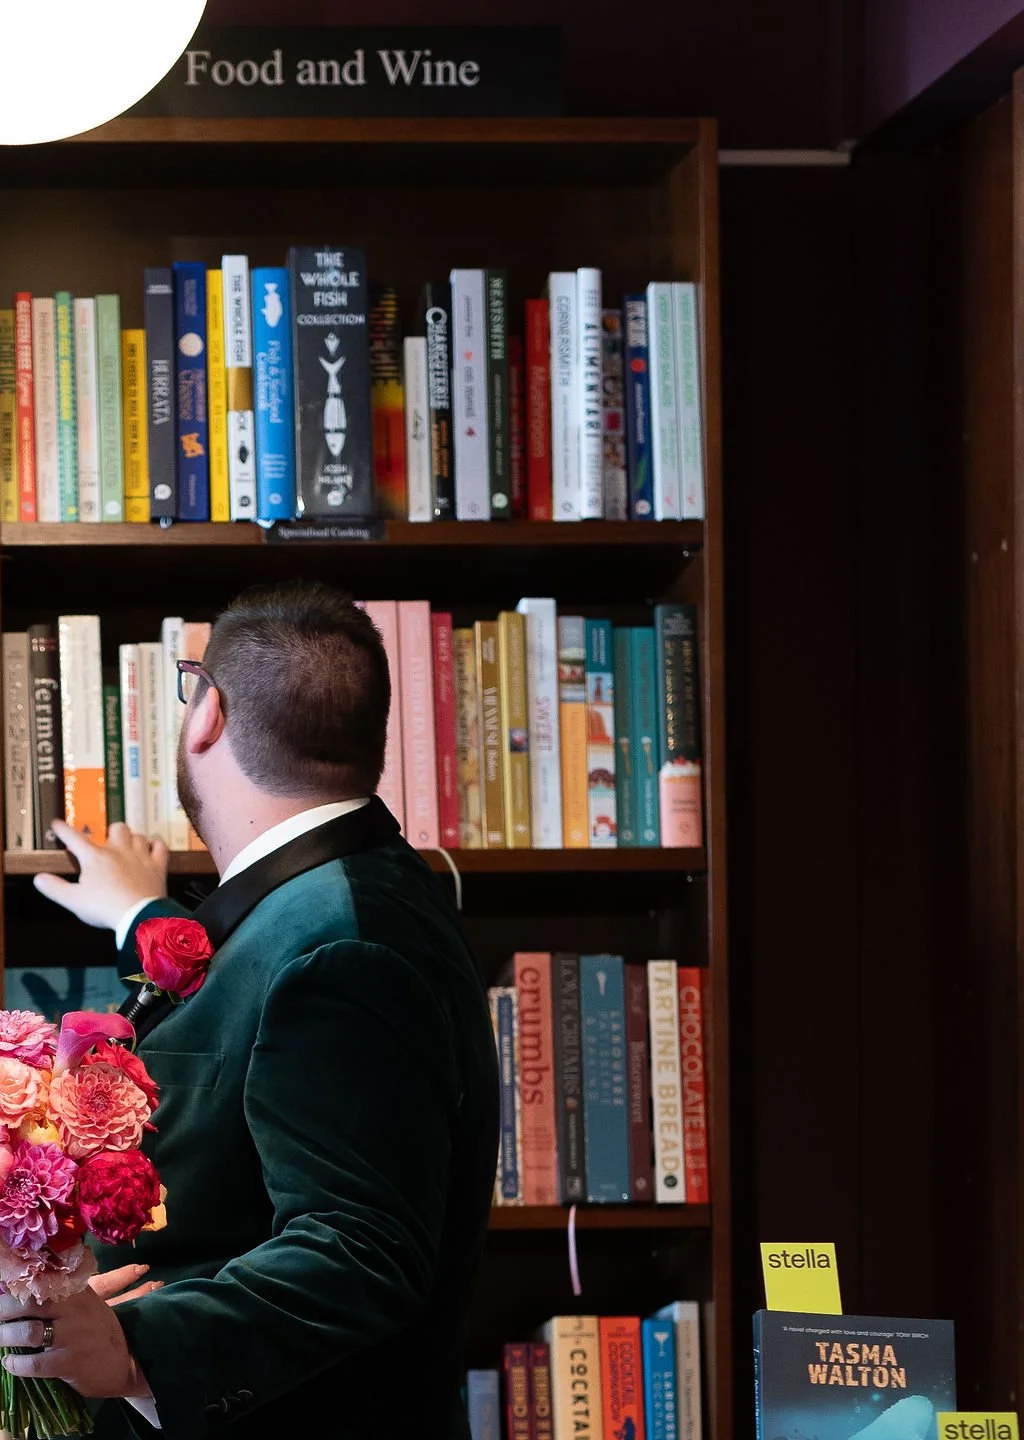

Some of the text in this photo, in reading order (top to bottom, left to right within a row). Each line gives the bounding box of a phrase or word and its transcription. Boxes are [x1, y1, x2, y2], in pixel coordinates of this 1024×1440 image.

[184, 49, 480, 86] Food and Wine
[300, 271, 360, 287] WHOLE
[314, 252, 344, 267] THE
[232, 275, 245, 362] THE WHOLE FISH
[297, 314, 365, 326] COLLECTION
[313, 291, 347, 306] FISH
[489, 278, 504, 359] MEATSMITH
[18, 300, 32, 371] GLUTEN FREE
[426, 306, 449, 409] CHARCUTERIE
[557, 295, 571, 387] CORNERSMITH
[152, 360, 170, 425] BURRATA
[257, 352, 268, 411] Cookbook
[266, 340, 283, 424] Fish Seafood
[584, 323, 600, 440] ALIMENTARI
[530, 365, 545, 458] Mushroom
[34, 678, 57, 784] ferment
[106, 696, 117, 736] Pocket
[535, 696, 551, 752] SWEET
[560, 959, 578, 1011] LOVE
[520, 967, 549, 1105] crumbs
[679, 985, 703, 1133] CHOCOLATE
[655, 963, 680, 1172] TARTINE BREAD
[767, 1248, 831, 1269] stella
[807, 1363, 907, 1389] WALTON
[815, 1341, 899, 1366] TASMA
[512, 1366, 527, 1417] BEHIND
[534, 1366, 549, 1417] BEHIND
[944, 1418, 1012, 1440] stella
